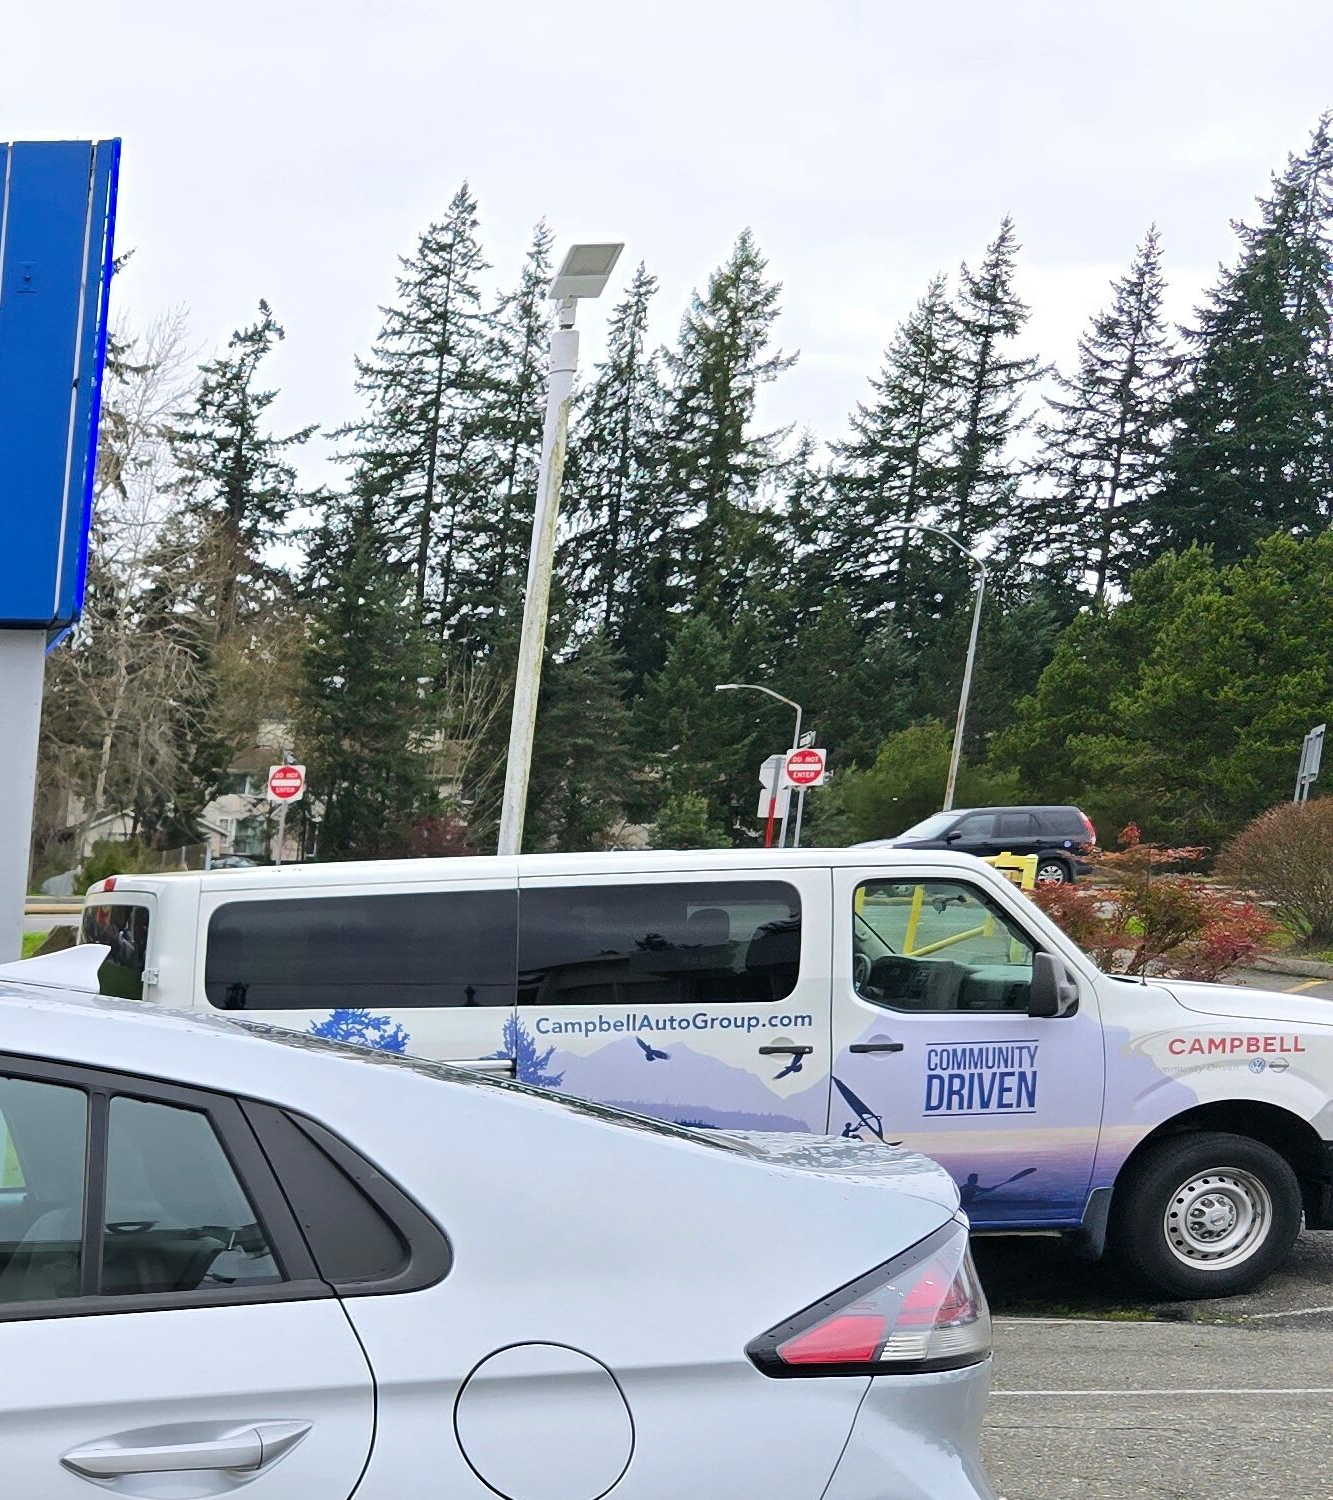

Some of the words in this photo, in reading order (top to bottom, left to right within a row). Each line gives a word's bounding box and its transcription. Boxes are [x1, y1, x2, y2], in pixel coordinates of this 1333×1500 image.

[535, 1012, 813, 1038] CampbellAutoGroup.com
[927, 1045, 1039, 1071] COMMUNITY
[1168, 1035, 1306, 1055] CAMPBELL
[924, 1070, 1038, 1112] DRIVEN
